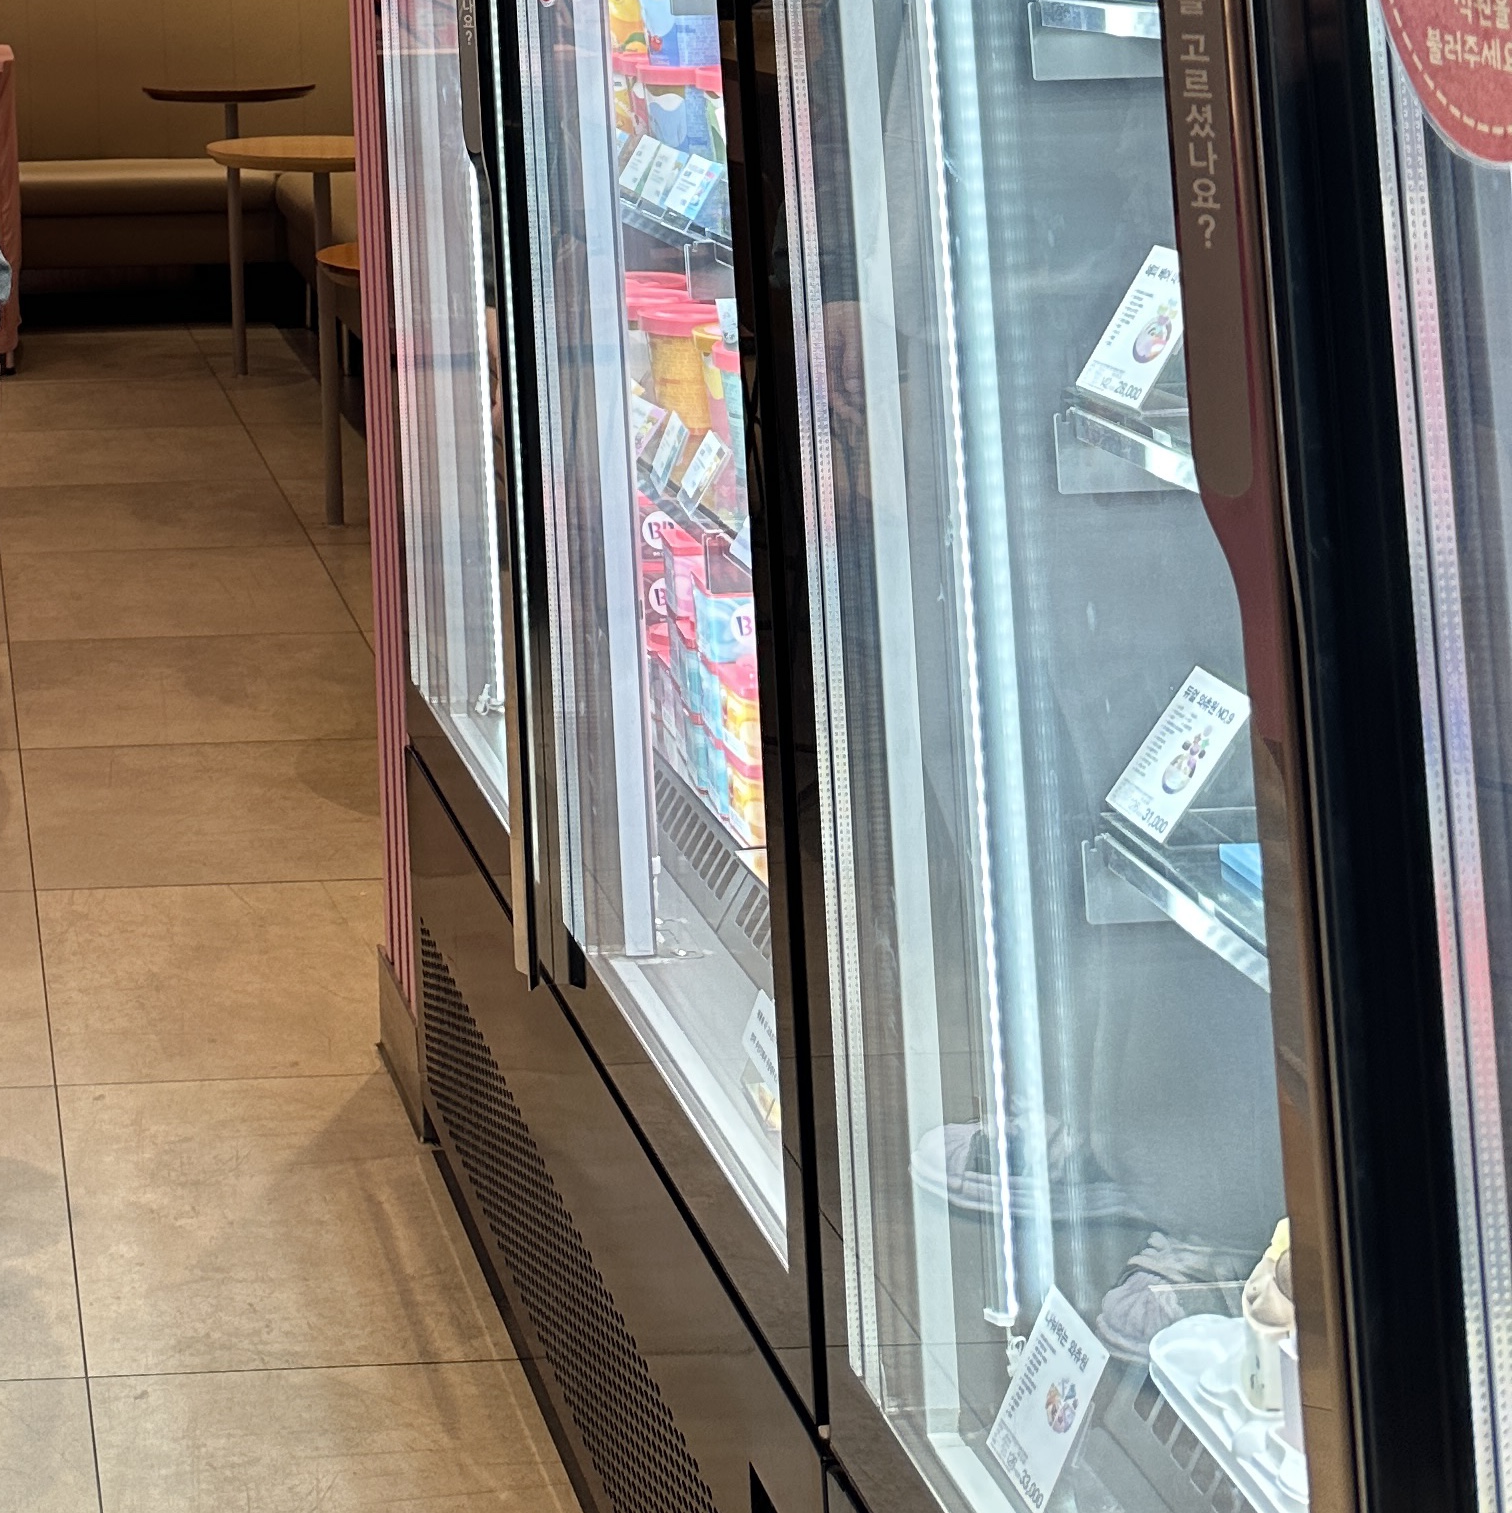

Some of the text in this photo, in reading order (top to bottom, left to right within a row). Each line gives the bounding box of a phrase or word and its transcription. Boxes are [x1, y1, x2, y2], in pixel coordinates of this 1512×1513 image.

[1180, 33, 1221, 250] 고르셨나요?
[1182, 684, 1201, 703] 듀얼
[1141, 808, 1169, 834] 31,000
[1044, 1310, 1090, 1373] 나눠먹는 와츄원
[1019, 1469, 1044, 1509] 33,000
